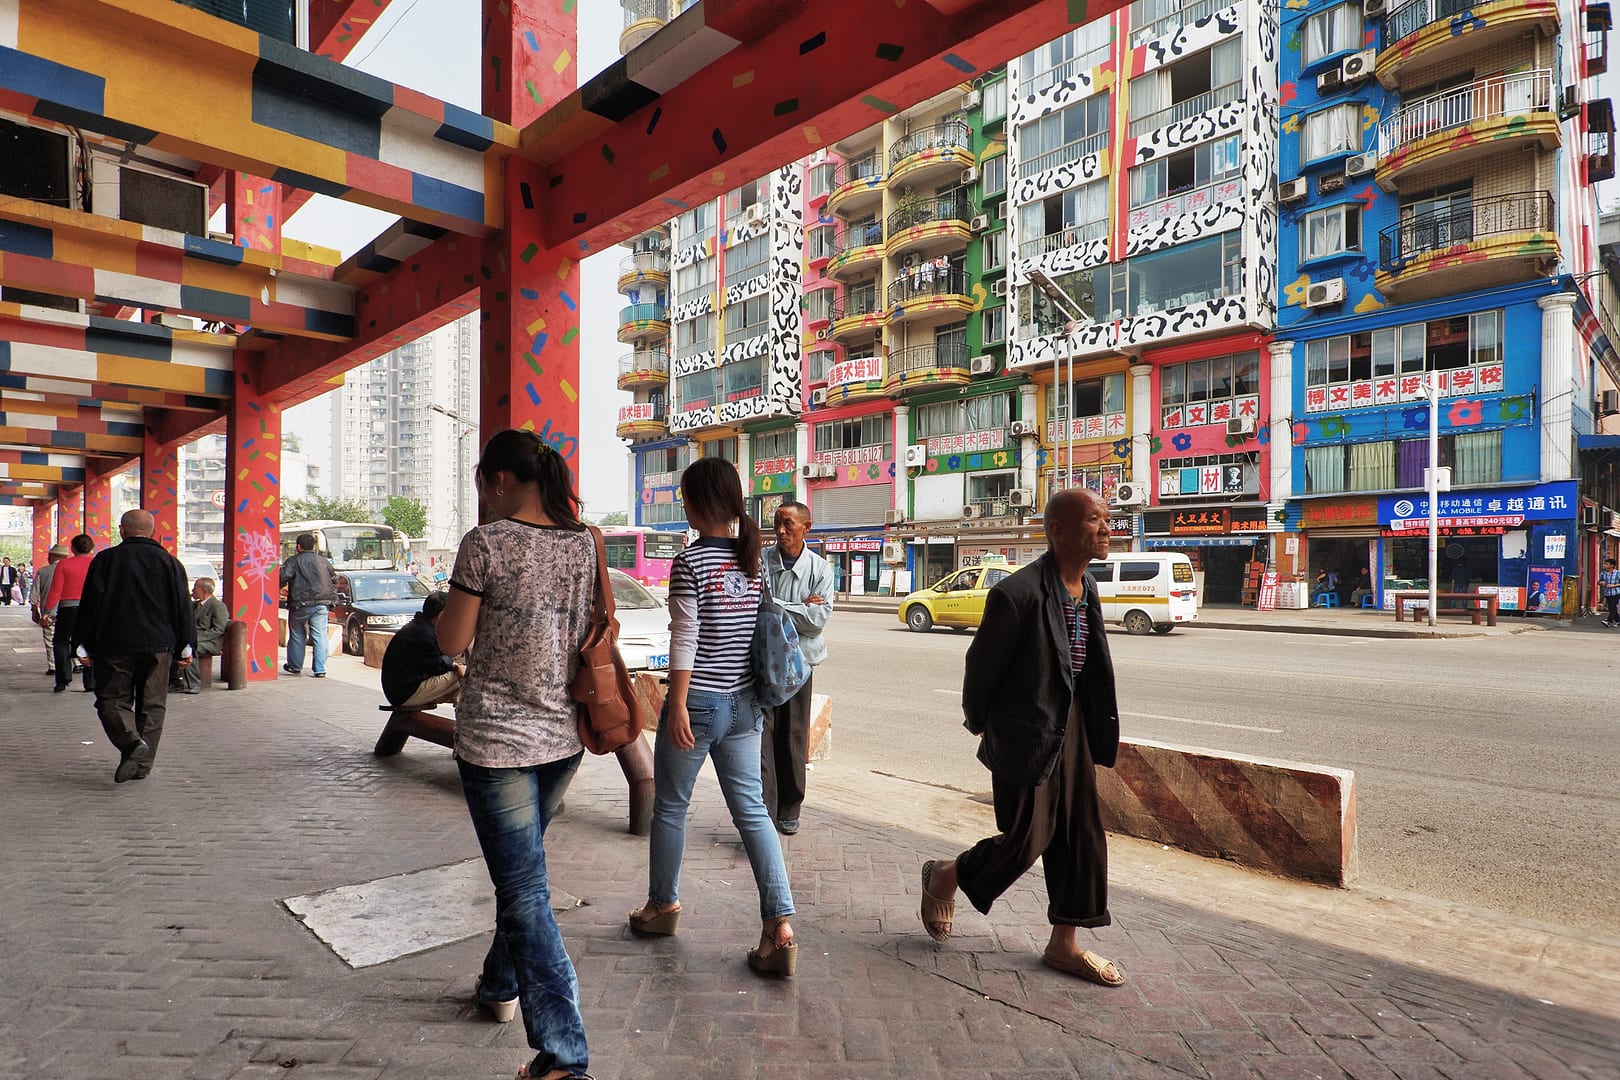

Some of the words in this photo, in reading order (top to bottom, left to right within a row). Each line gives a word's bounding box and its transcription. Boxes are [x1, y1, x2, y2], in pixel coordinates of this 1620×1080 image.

[1167, 400, 1256, 427] 博文美术
[929, 430, 1003, 451] 源流美术培训
[1204, 468, 1220, 491] 材
[1420, 498, 1483, 509] 中移动通信
[1486, 495, 1568, 513] 卓越通讯
[1451, 507, 1483, 515] MOBILE
[1231, 521, 1267, 530] 美术用品
